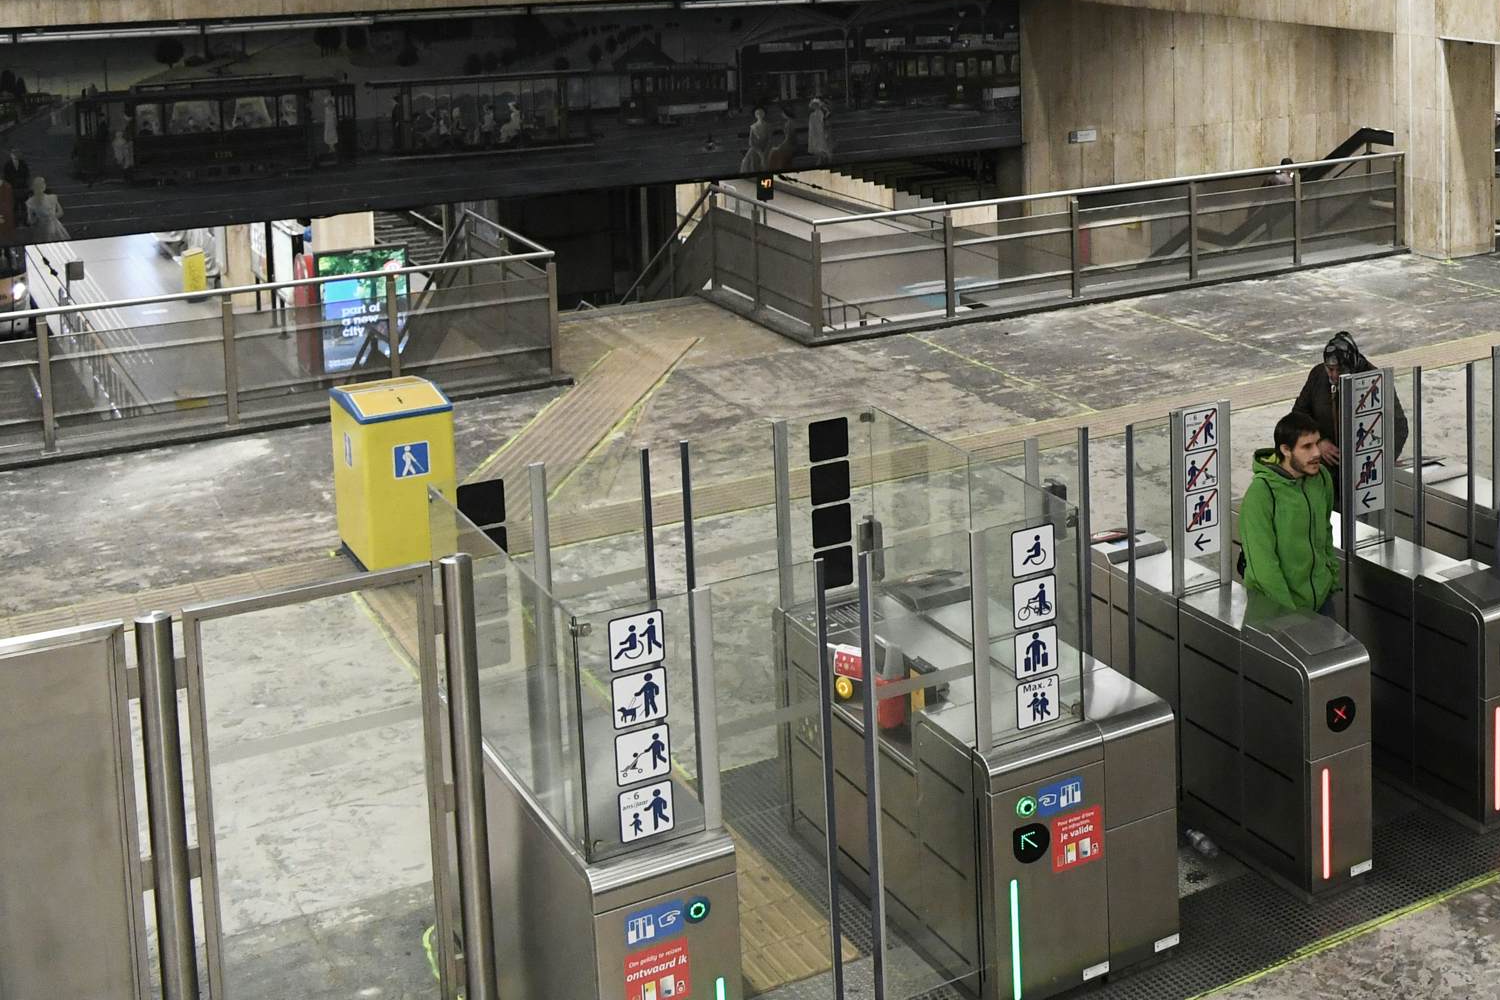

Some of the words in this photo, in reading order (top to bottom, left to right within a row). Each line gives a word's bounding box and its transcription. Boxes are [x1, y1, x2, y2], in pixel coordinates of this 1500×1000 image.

[342, 304, 367, 318] part
[369, 302, 380, 312] of
[353, 314, 379, 324] new
[342, 325, 365, 337] city
[1023, 682, 1046, 694] Max.
[1047, 678, 1053, 687] 2
[633, 791, 640, 800] 6
[1060, 832, 1069, 844] je
[1070, 824, 1094, 838] valide
[628, 961, 640, 969] Om
[640, 954, 658, 966] geldig
[626, 957, 676, 983] ontwaard
